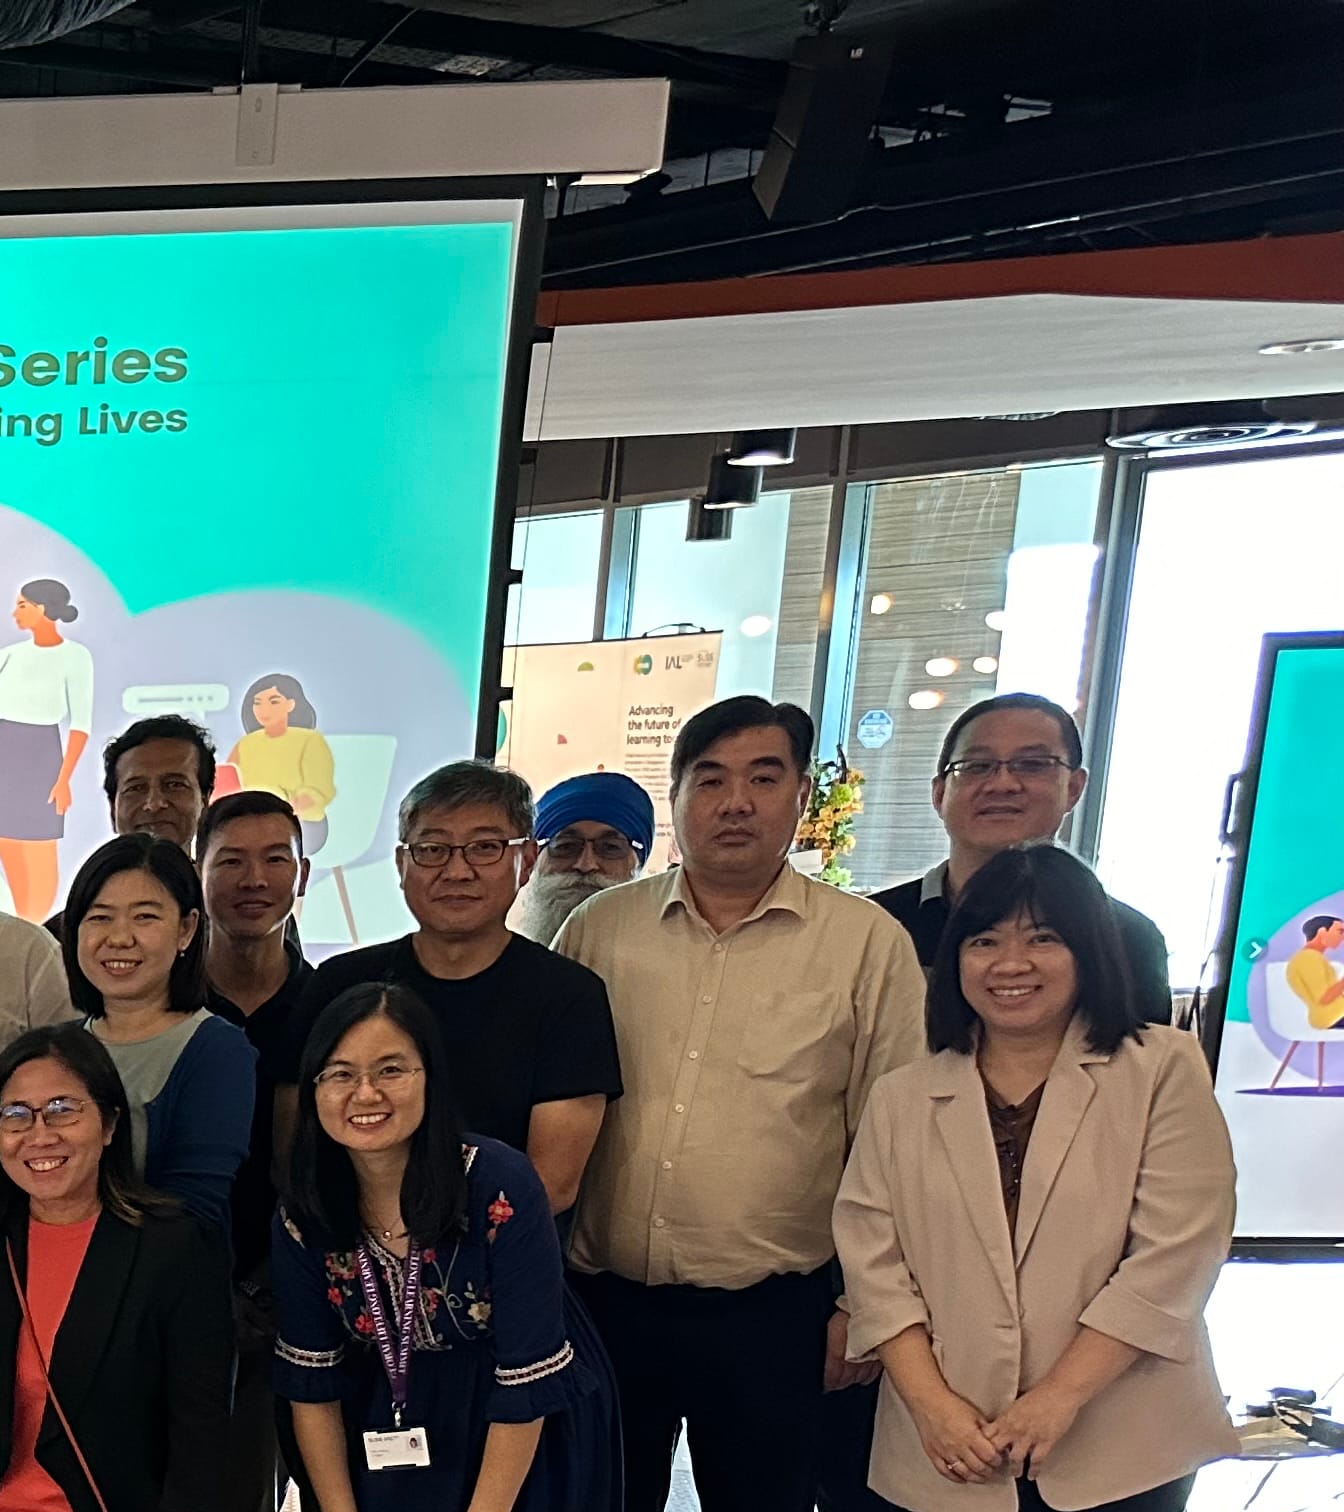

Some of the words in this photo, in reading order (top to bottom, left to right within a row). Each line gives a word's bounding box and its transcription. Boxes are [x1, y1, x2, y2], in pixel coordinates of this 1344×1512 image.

[78, 403, 189, 436] Lives
[628, 704, 674, 717] Advancing
[628, 720, 642, 730] the
[644, 719, 670, 730] future
[672, 718, 682, 730] of
[627, 734, 661, 747] learning
[402, 1285, 417, 1334] LEARNING
[398, 1335, 410, 1374] SUMMIT
